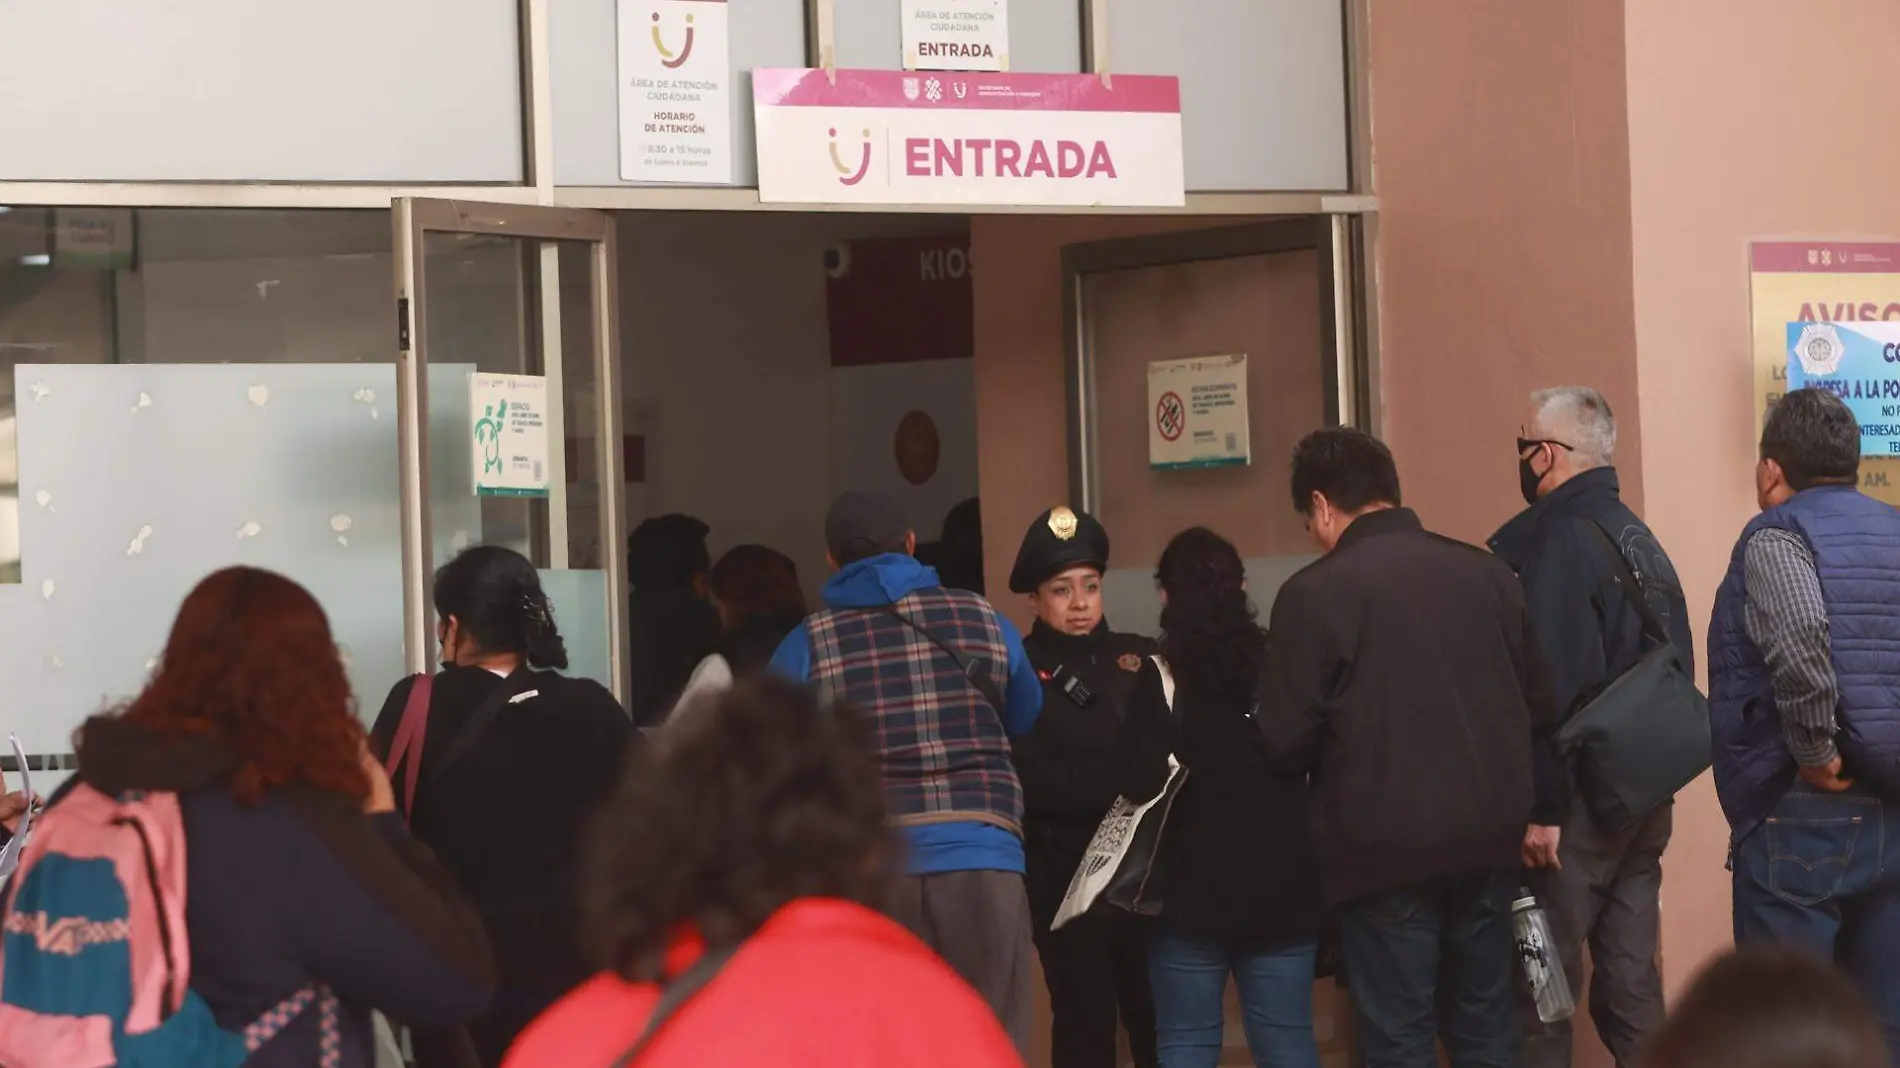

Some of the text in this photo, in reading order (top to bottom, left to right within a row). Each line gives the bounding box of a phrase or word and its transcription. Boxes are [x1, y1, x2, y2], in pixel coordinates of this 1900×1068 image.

[939, 11, 951, 20] DE
[952, 10, 994, 20] ATENCIÓN
[930, 23, 980, 32] CIUDADANA
[918, 42, 993, 58] ENTRADA
[657, 80, 669, 88] DE
[671, 80, 718, 90] ATENCIÓN
[647, 92, 701, 101] CIUDADANA
[654, 112, 696, 121] HORARIO
[644, 124, 705, 133] DE ATENCIÓN
[905, 138, 1118, 178] ENTRADA
[920, 247, 973, 281] KIO
[1854, 380, 1863, 398] A
[1866, 380, 1880, 398] LA
[1882, 405, 1895, 417] NO
[1864, 472, 1891, 487] AM.
